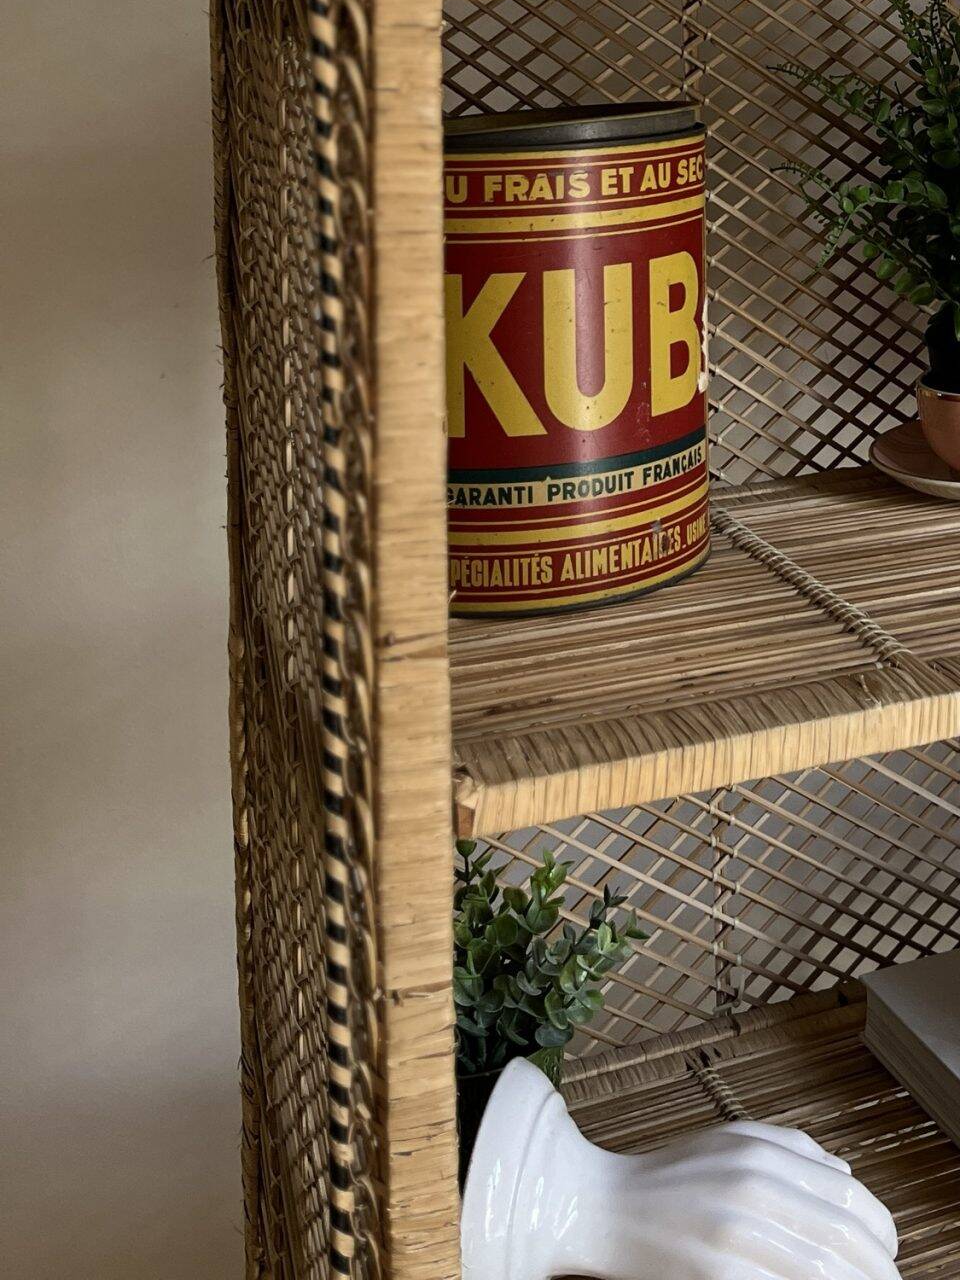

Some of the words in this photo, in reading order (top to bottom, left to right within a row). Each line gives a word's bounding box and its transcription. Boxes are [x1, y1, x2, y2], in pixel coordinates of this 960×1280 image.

[445, 175, 468, 203] U
[484, 172, 591, 203] FRAIS
[601, 167, 634, 196] ET
[640, 164, 671, 192] AU
[677, 155, 703, 186] SEC
[445, 251, 700, 438] KUB
[547, 472, 634, 502] PRODUIT
[642, 446, 702, 485] FRANÇAIS
[449, 553, 552, 589] PÉCIALITÉS
